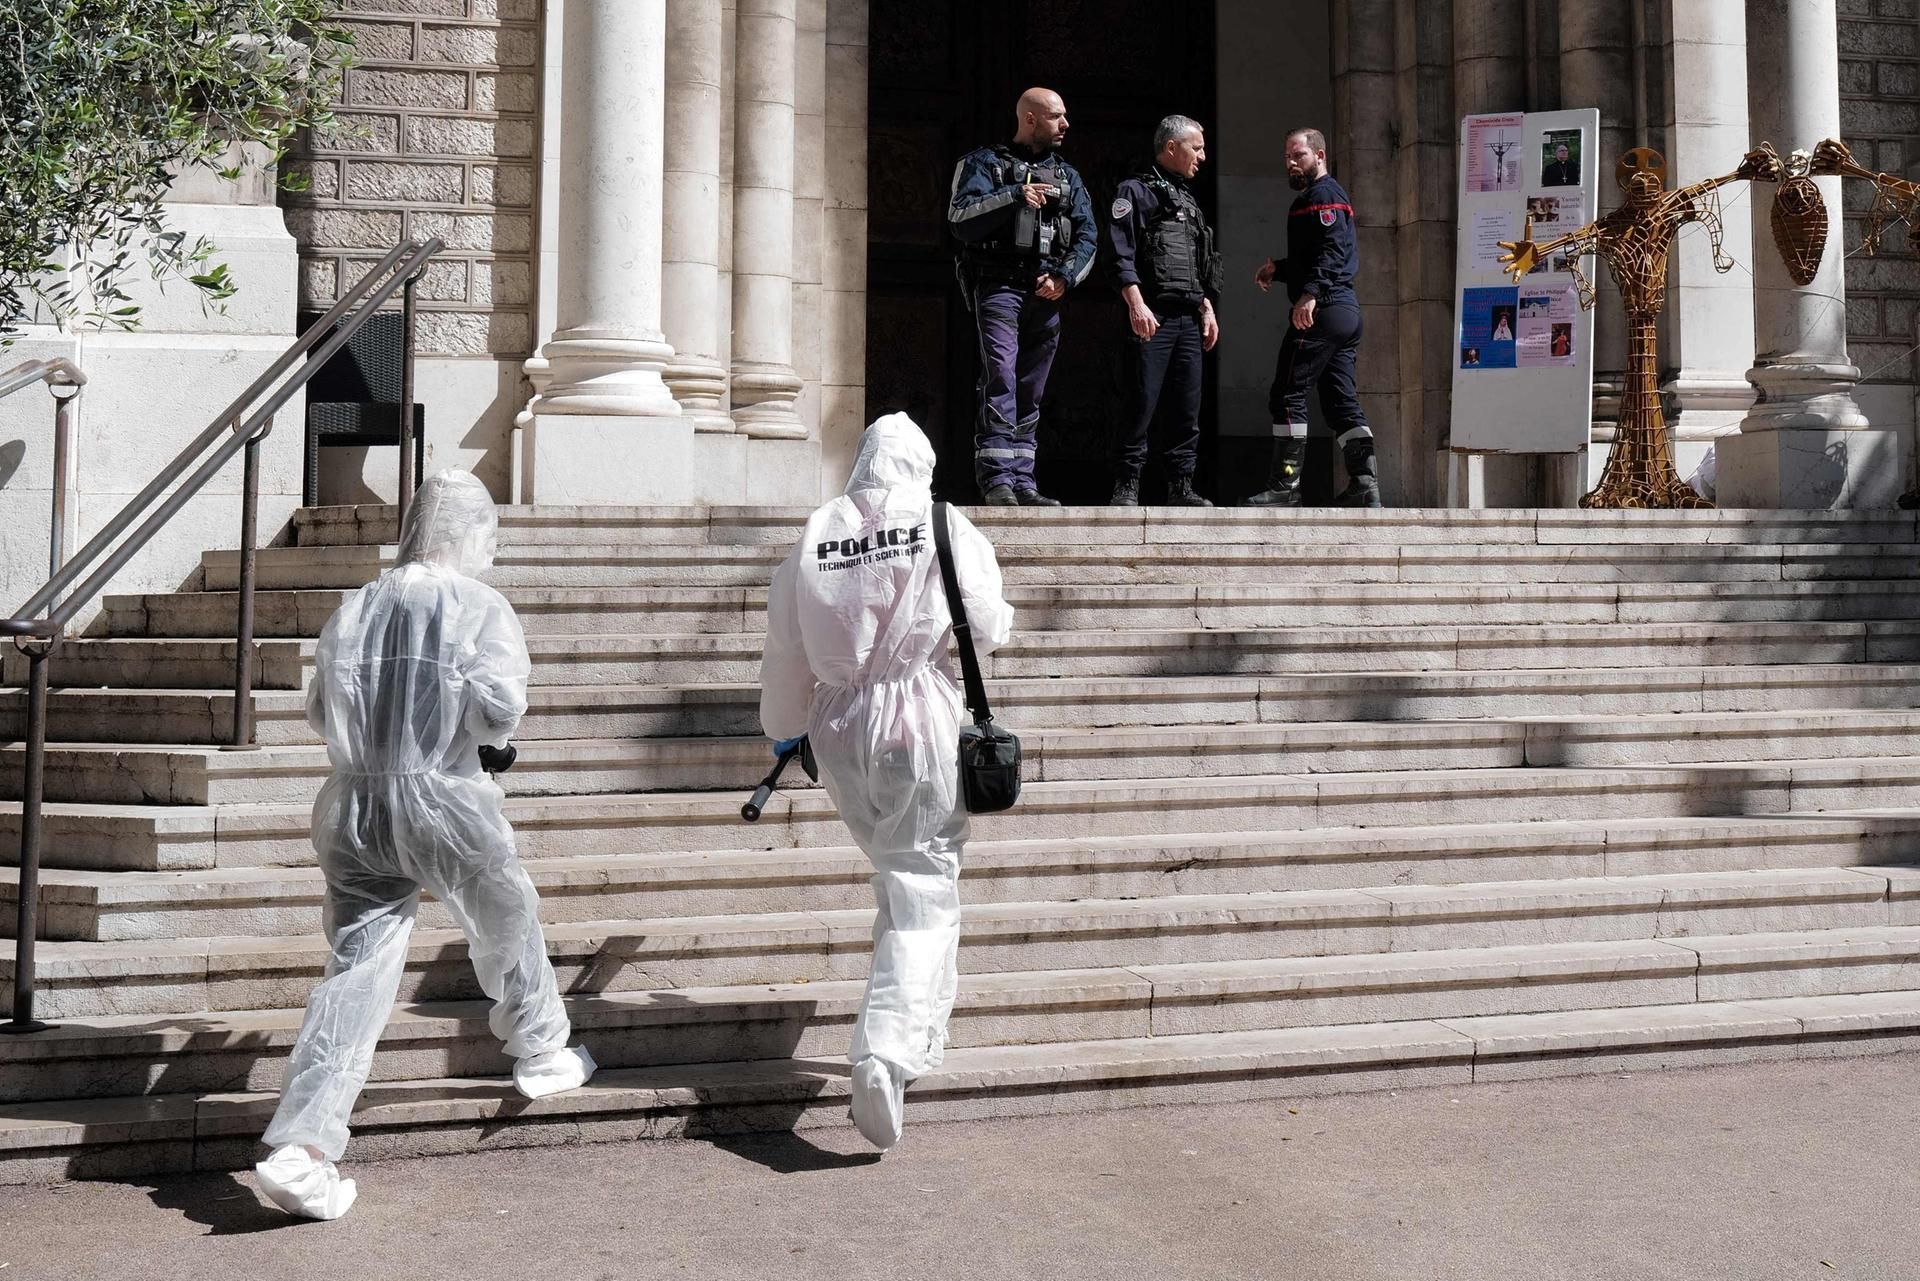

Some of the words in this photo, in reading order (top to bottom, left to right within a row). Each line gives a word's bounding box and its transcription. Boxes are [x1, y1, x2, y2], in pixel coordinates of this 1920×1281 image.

[817, 522, 926, 560] POLICE
[818, 558, 863, 572] TECHNIQUE
[863, 555, 872, 566] ET
